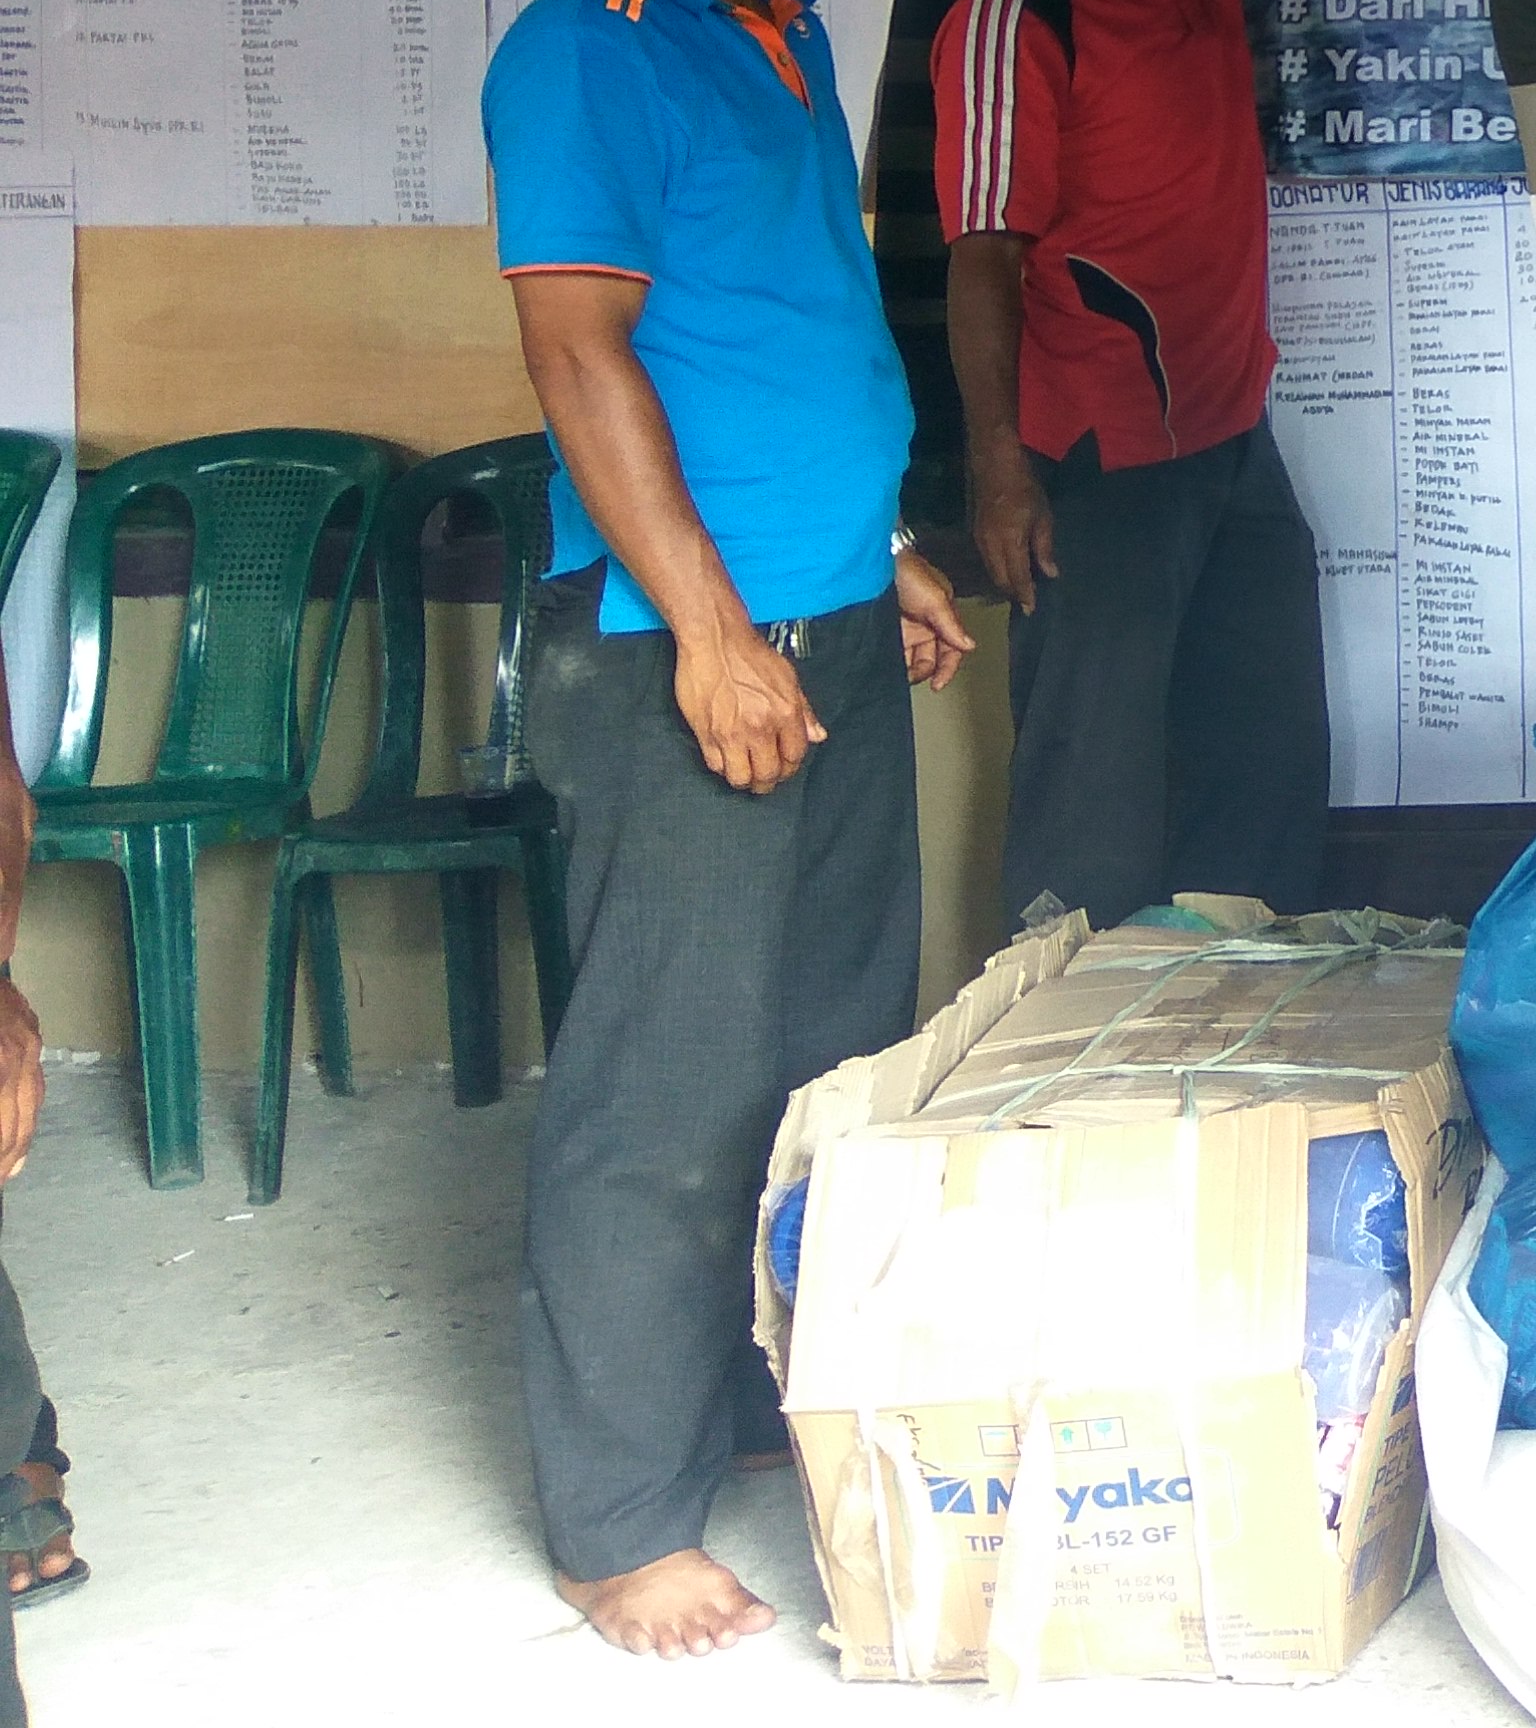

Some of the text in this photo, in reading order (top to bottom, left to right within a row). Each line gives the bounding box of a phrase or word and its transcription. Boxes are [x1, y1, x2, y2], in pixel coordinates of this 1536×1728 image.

[1279, 48, 1309, 83] #
[1324, 47, 1463, 82] Yakin
[1279, 108, 1518, 143] # Mari Be
[0, 190, 66, 211] TERANGAN
[1269, 182, 1369, 209] DONATUR
[1388, 179, 1444, 202] JENIS
[965, 1534, 1003, 1553] TIP
[1142, 1524, 1177, 1544] GF
[1083, 1563, 1110, 1575] SET
[1055, 1579, 1090, 1591] RSIH
[1156, 1574, 1176, 1588] Kg
[1159, 1590, 1178, 1605] Kg
